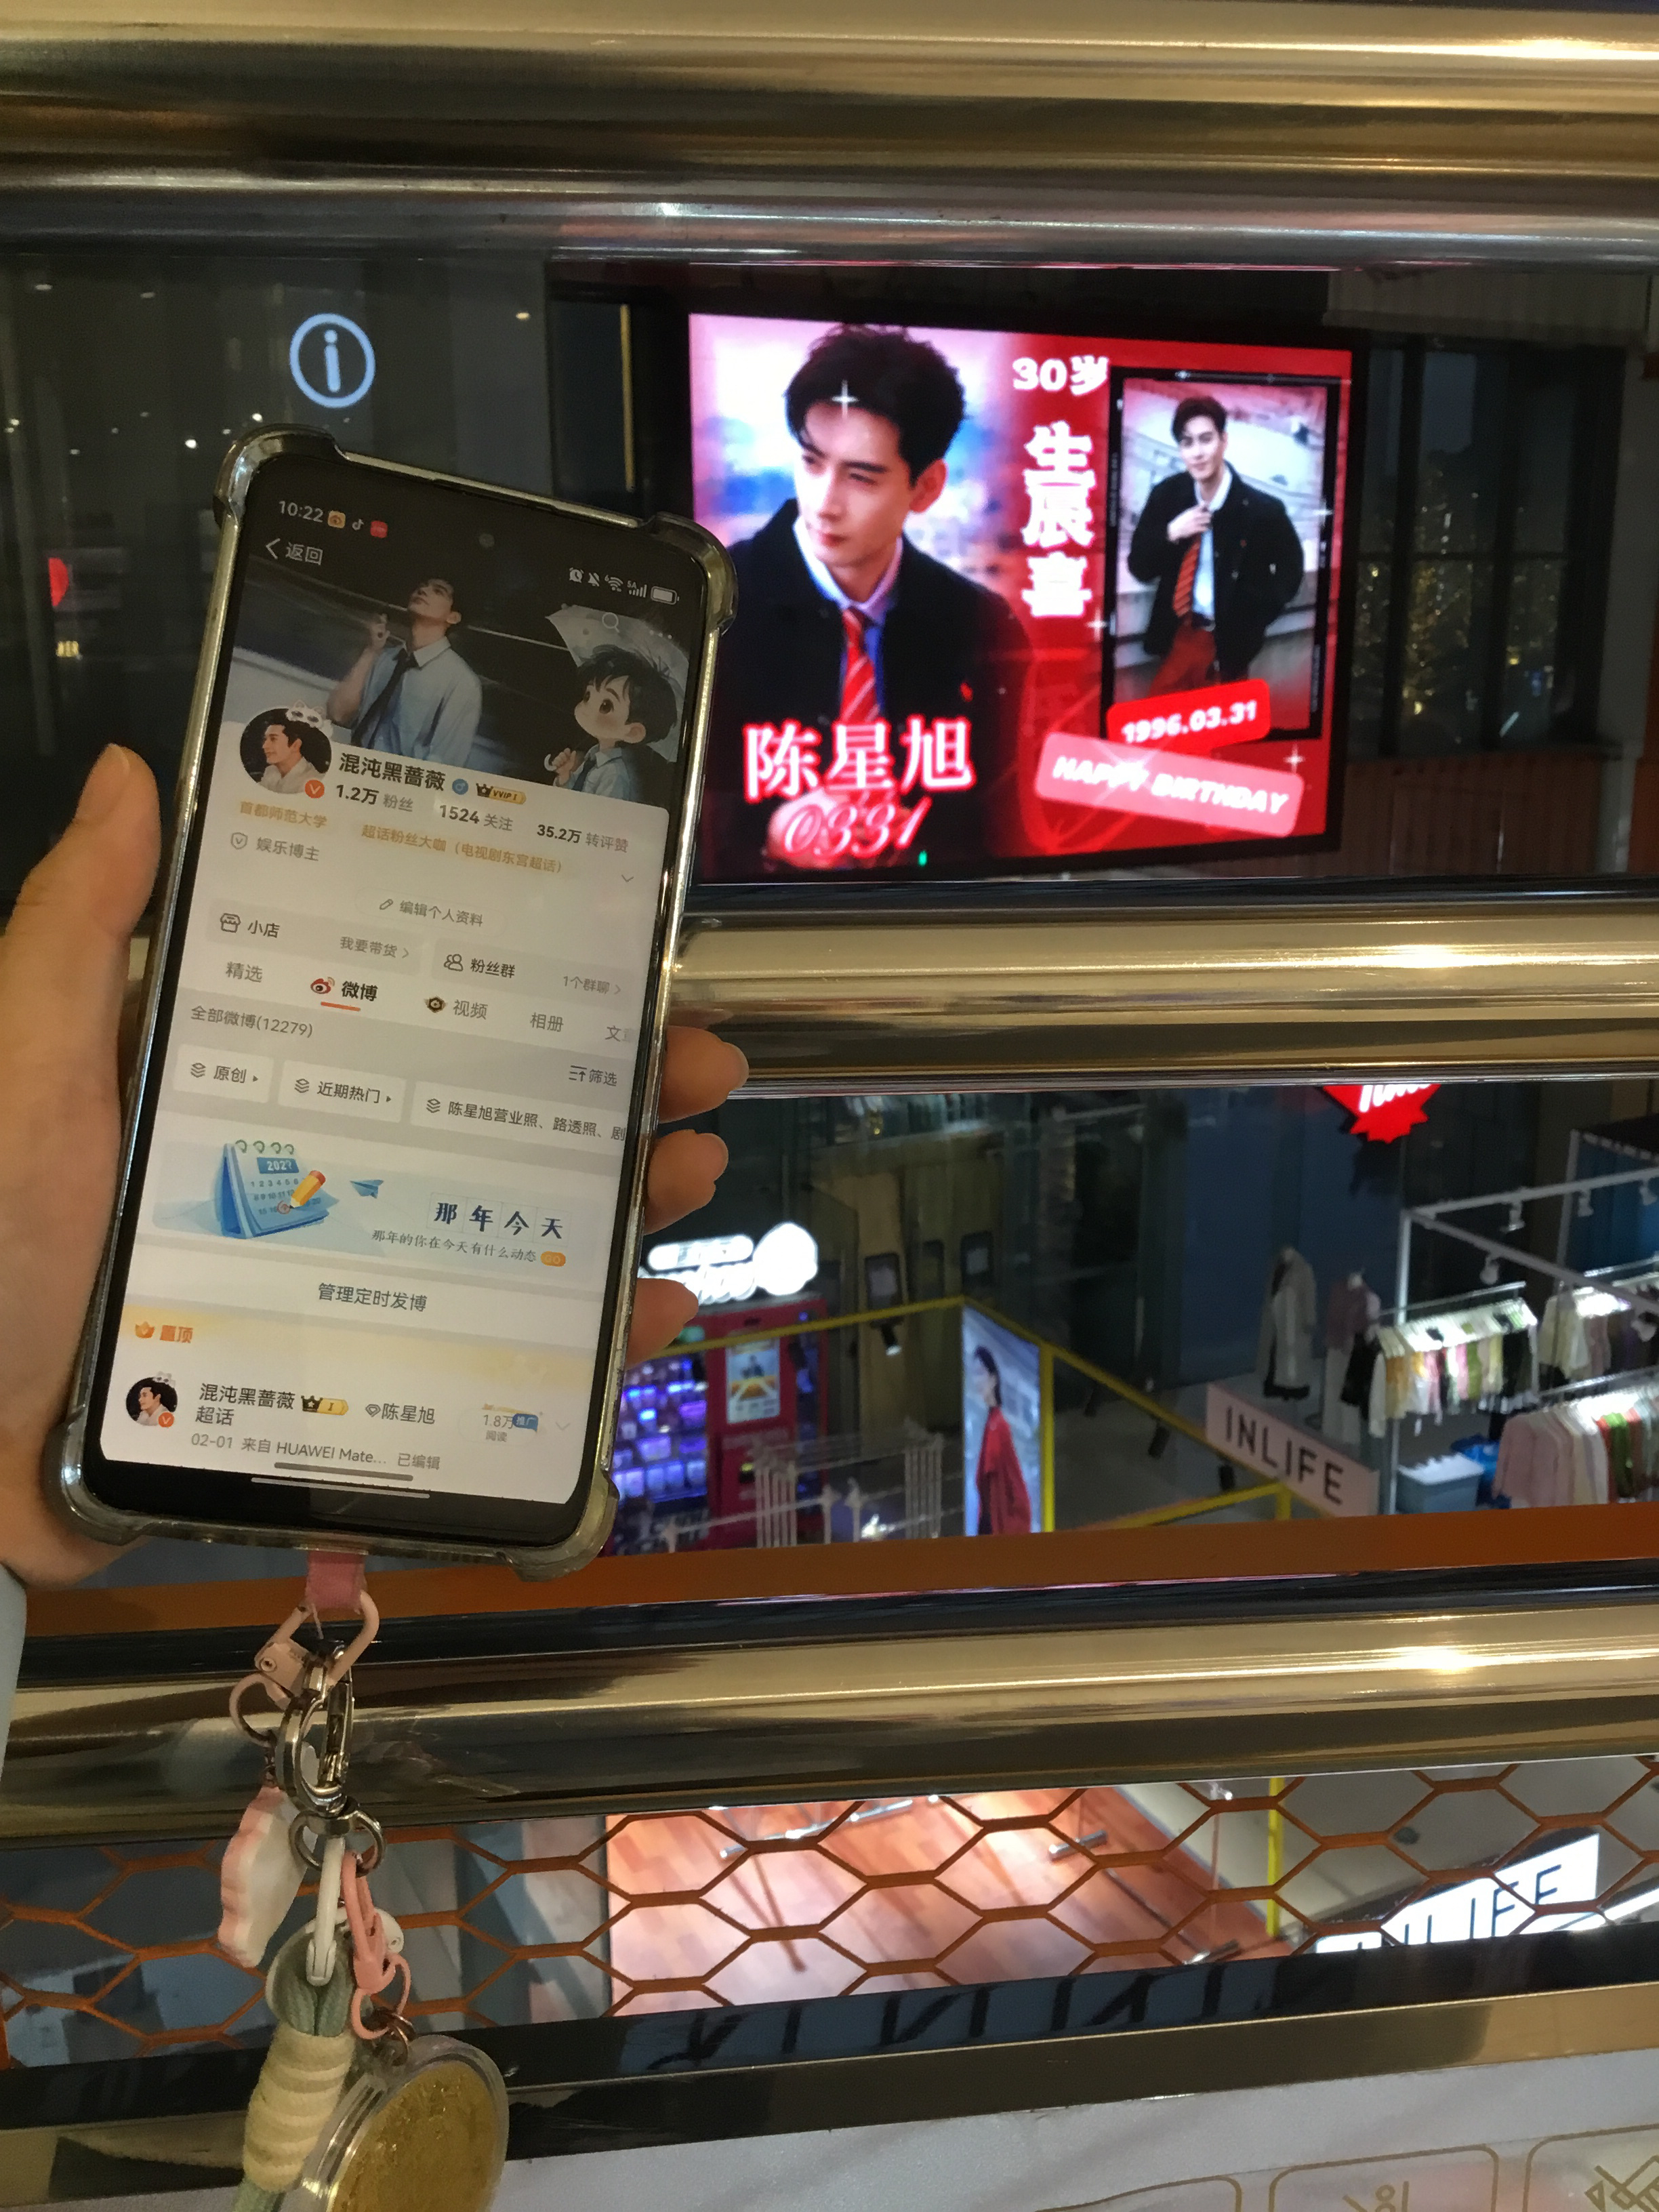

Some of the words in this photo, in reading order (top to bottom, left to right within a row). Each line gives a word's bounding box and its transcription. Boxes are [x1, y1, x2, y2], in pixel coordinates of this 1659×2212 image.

[1012, 354, 1109, 396] 30岁
[279, 501, 323, 523] 10:22
[1021, 420, 1096, 618] 生辰喜
[285, 542, 323, 565] 返回
[1121, 699, 1258, 743] 1996.03.31
[743, 714, 976, 804] 陈星旭
[339, 753, 446, 791] 混沌黑蔷薇
[1053, 756, 1149, 792] HAPPY
[1151, 773, 1289, 815] BIRTHDAY
[337, 785, 379, 805] 1.2万
[383, 794, 413, 812] 粉丝
[240, 801, 327, 829] 首都师范大学
[440, 805, 480, 824] 1524
[483, 813, 513, 832] 关注
[256, 837, 320, 861] 娱乐博主
[537, 824, 582, 844] 35.2万
[586, 832, 628, 853] 转评赞
[400, 900, 483, 926] 编辑个人资料
[248, 920, 280, 938] 小店
[340, 936, 398, 958] 我要带货
[226, 961, 263, 983] 精选
[470, 958, 515, 979] 粉丝群
[342, 981, 378, 1002] 微博
[563, 976, 609, 995] 1个群聊
[190, 1005, 313, 1038] 全部微博(12279)
[453, 999, 488, 1021] 视频
[530, 1012, 563, 1032] 相册
[213, 1065, 247, 1084] 原创
[589, 1069, 617, 1086] 筛选
[316, 1081, 380, 1103] 近期热门
[434, 1202, 562, 1240] 那年今天
[372, 1230, 536, 1262] 那年的你在今天有什么动态
[319, 1283, 427, 1312] 管理定时发博
[199, 1382, 295, 1410] 混沌黑蔷薇
[196, 1406, 234, 1426] 超话
[381, 1403, 435, 1425] 陈星旭
[483, 1414, 514, 1429] 1.8万
[486, 1430, 507, 1443] 阅读
[191, 1433, 232, 1448] 02-01
[241, 1437, 271, 1453] 来自
[276, 1441, 335, 1459] HUAWEI
[398, 1452, 440, 1470] 已编辑
[1225, 1406, 1344, 1507] INLIFE
